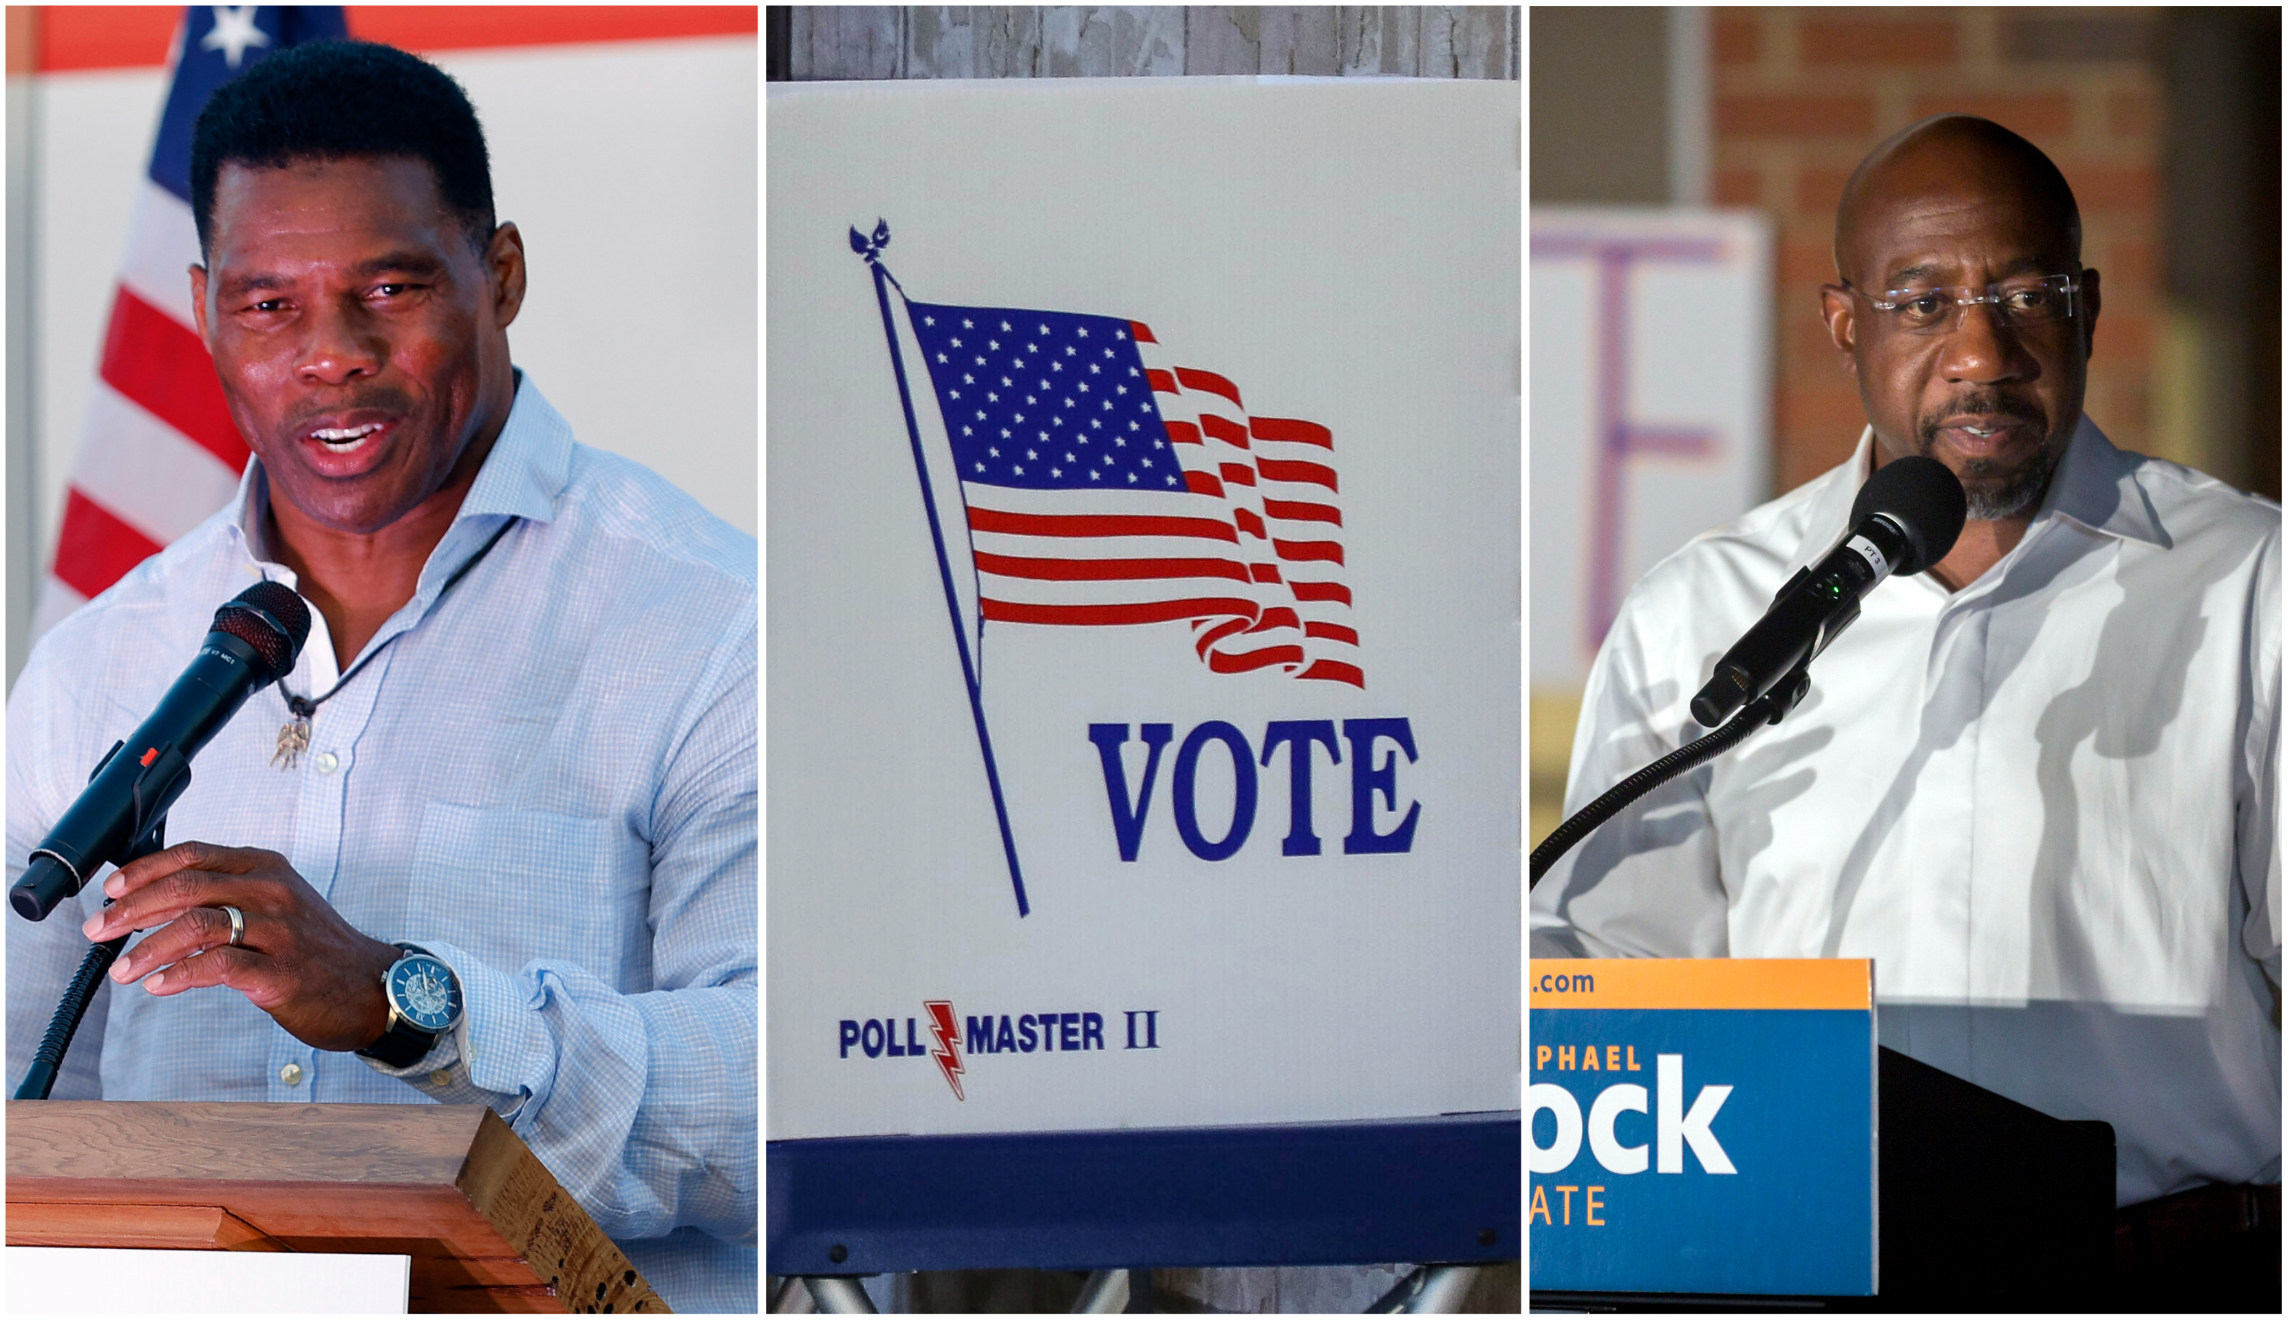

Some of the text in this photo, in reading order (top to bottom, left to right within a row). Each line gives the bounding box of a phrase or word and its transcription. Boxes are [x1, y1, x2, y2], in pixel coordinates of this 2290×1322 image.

[1864, 546, 1881, 565] PT 3
[1088, 717, 1422, 863] VOTE
[1532, 974, 1595, 993] .com
[839, 1010, 1161, 1059] POLL MASTER II
[1530, 1046, 1641, 1071] PHAEL
[1530, 1054, 1738, 1175] ock
[1530, 1186, 1605, 1226] ATE
